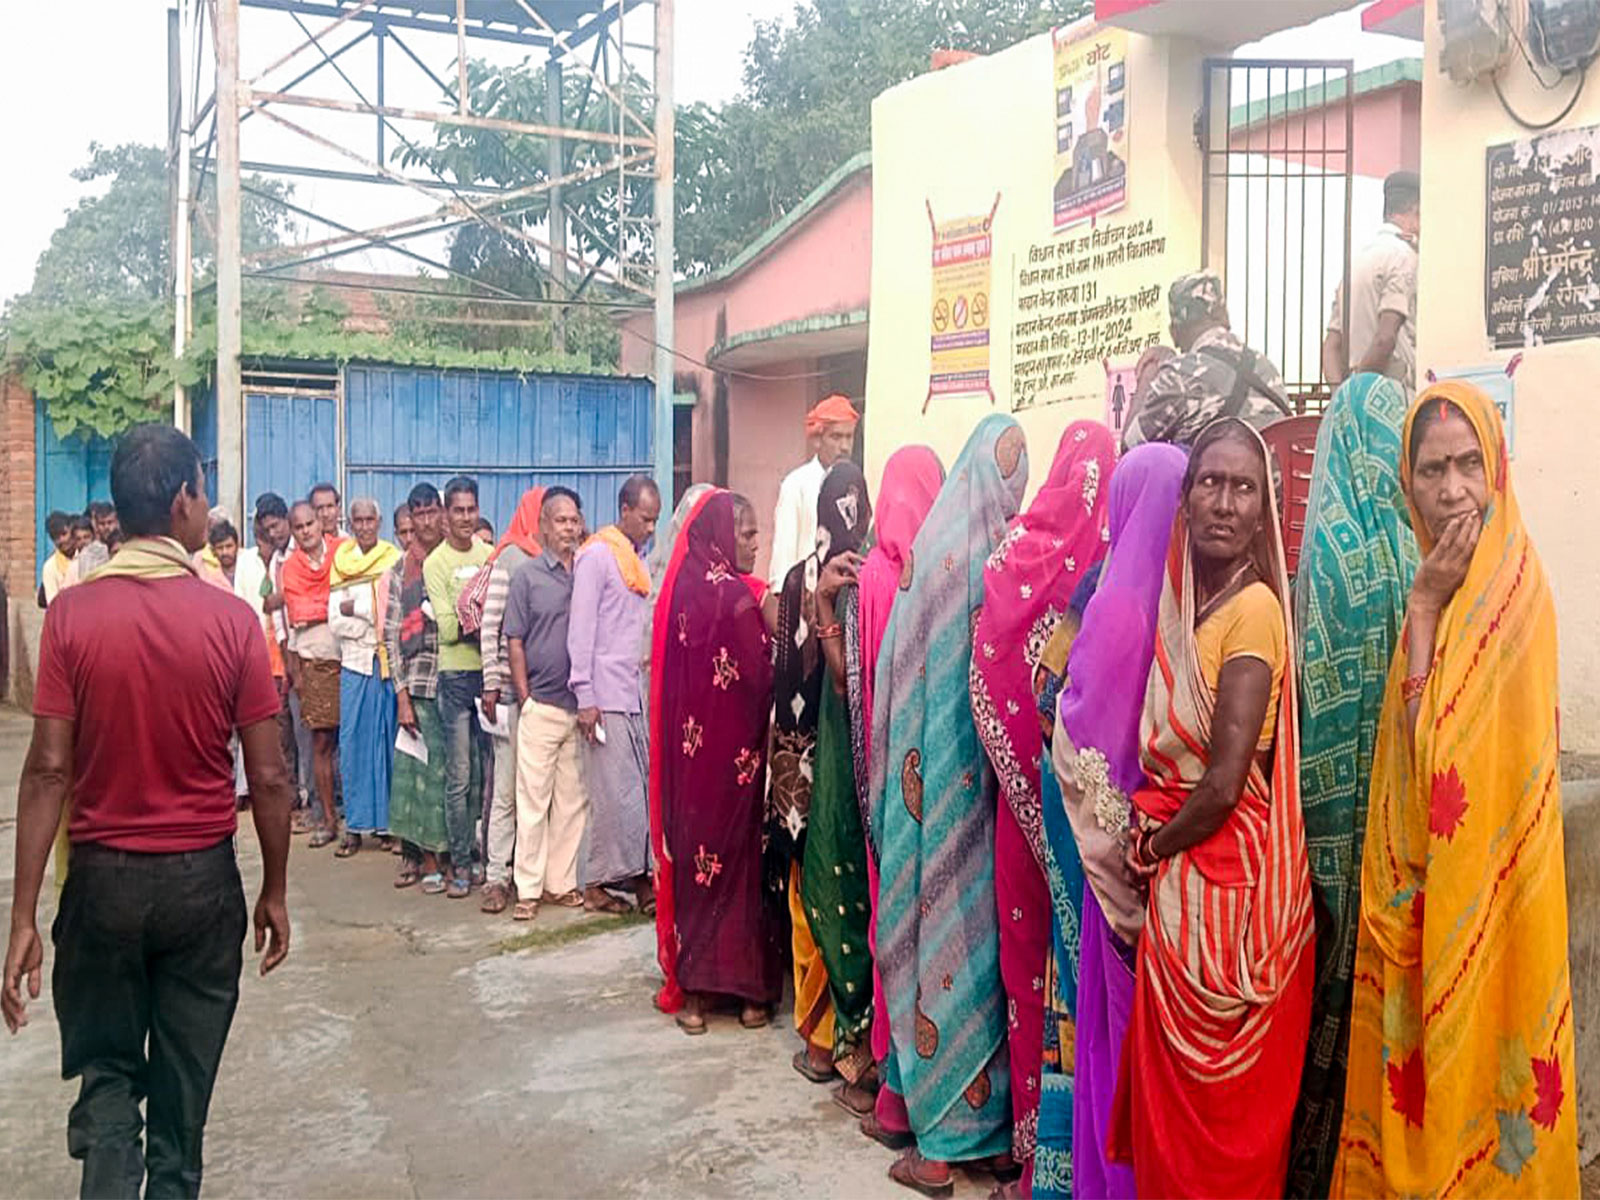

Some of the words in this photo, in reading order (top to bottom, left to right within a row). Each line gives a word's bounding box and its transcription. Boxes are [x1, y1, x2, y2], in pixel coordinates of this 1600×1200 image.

[1029, 244, 1055, 264] विधान
[1127, 219, 1153, 240] 2024
[1522, 246, 1540, 281] श्री
[1081, 281, 1097, 302] 131
